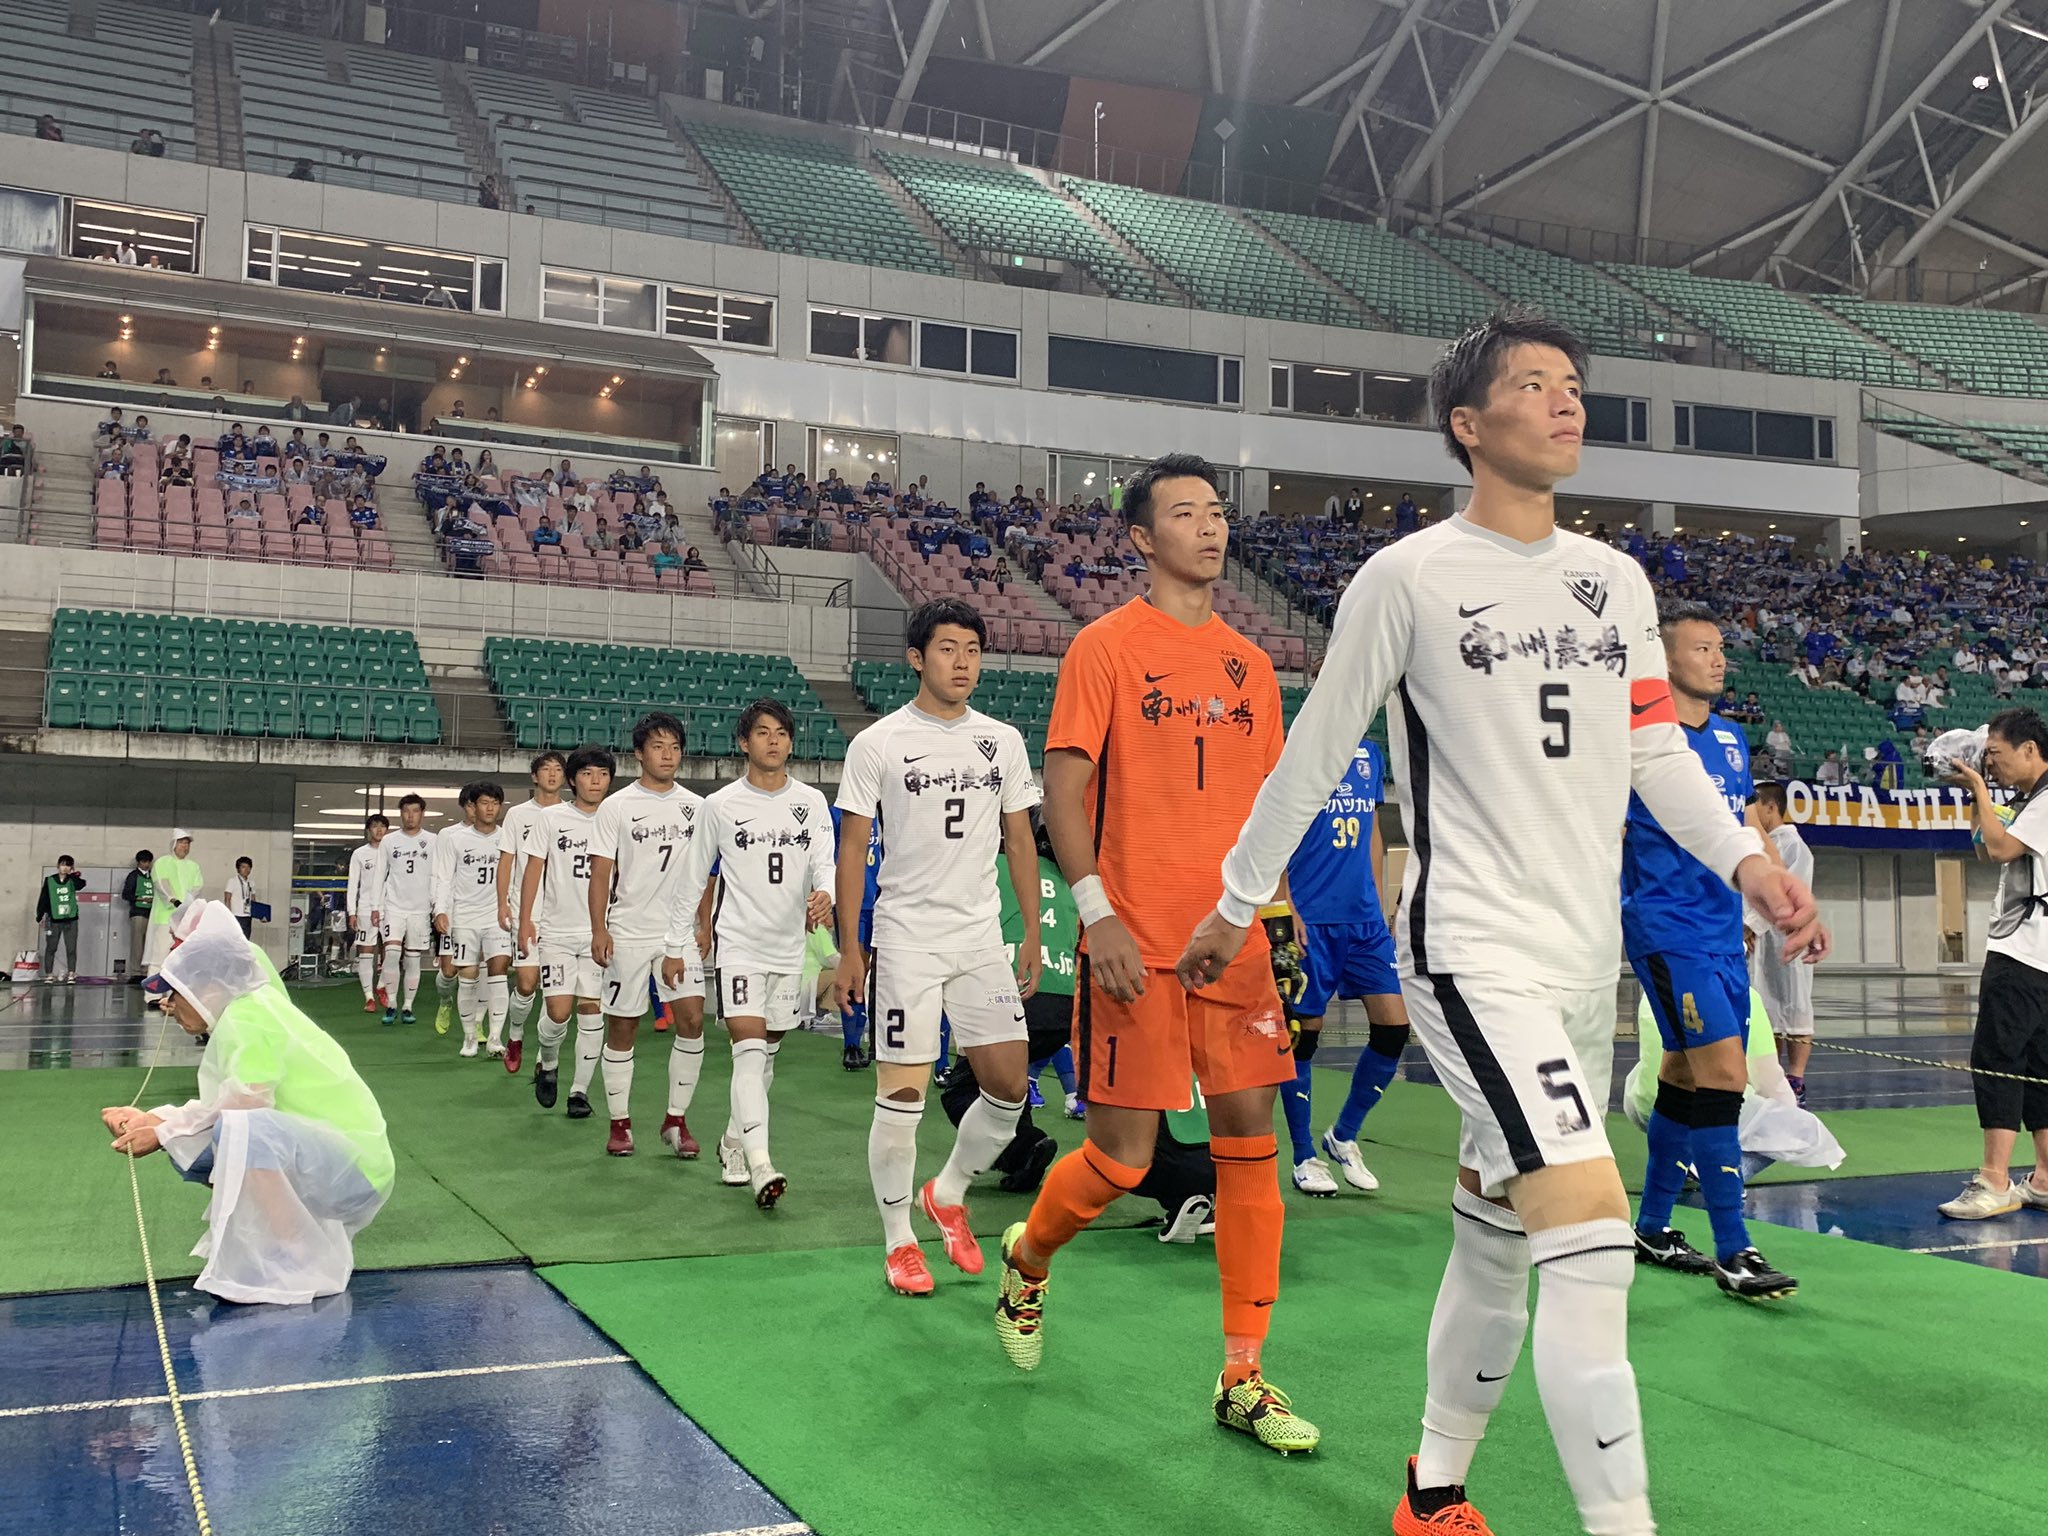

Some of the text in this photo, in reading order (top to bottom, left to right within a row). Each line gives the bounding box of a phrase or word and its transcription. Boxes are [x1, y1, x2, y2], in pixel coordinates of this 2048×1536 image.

[1563, 570, 1602, 578] KANOYA
[1540, 684, 1570, 757] 5
[1194, 736, 1204, 790] 1
[945, 799, 965, 839] 2
[1786, 780, 1886, 827] OITA
[1332, 817, 1360, 849] 39
[406, 860, 414, 873] 3
[658, 845, 672, 872] 7
[768, 853, 783, 884] 8
[477, 867, 494, 884] 31
[384, 925, 390, 937] 3
[609, 981, 621, 1006] 7
[732, 975, 748, 1005] 8
[887, 1009, 905, 1048] 2
[1682, 992, 1704, 1034] 4
[1106, 1036, 1118, 1087] 1
[1537, 1058, 1591, 1136] 5
